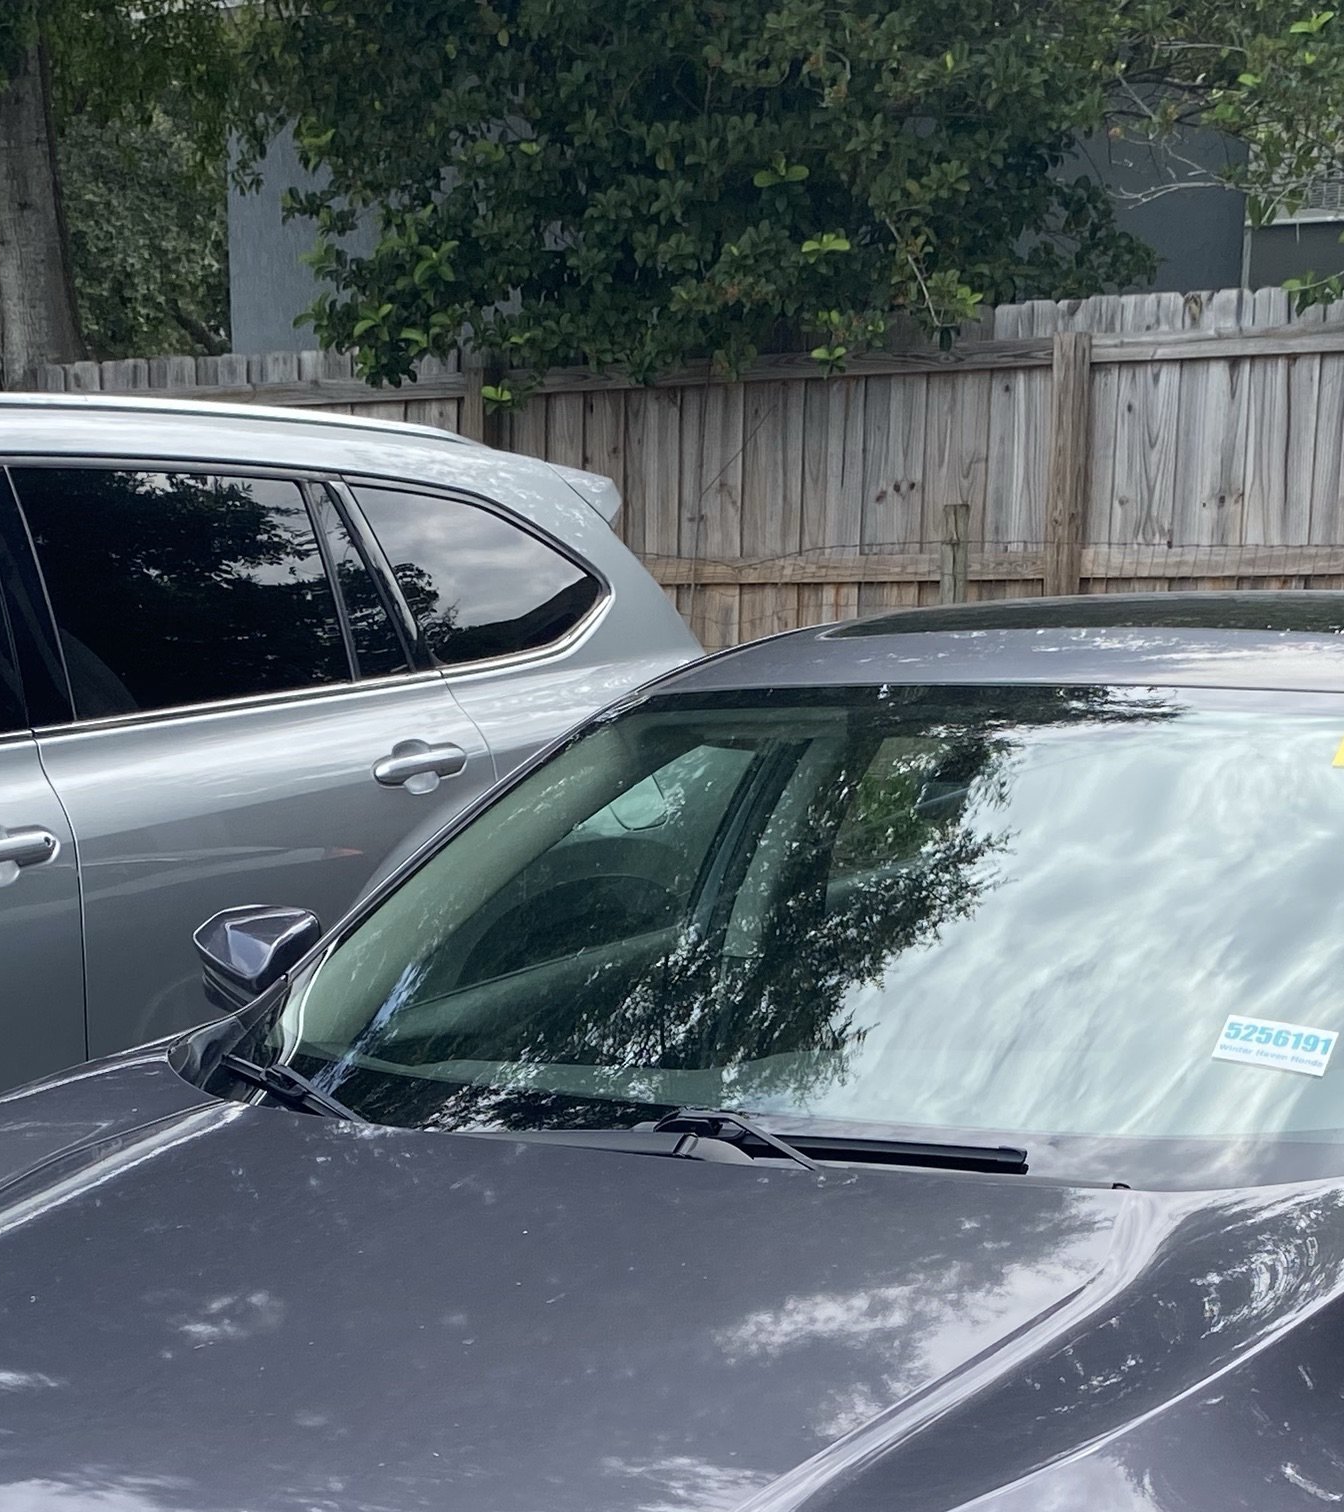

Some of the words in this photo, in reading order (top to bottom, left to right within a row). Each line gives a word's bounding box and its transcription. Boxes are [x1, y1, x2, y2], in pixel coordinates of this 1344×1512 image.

[1224, 1022, 1332, 1055] 5256191
[1219, 1043, 1253, 1056] Winter
[1256, 1049, 1288, 1061] Haven
[1290, 1054, 1325, 1068] Honda
